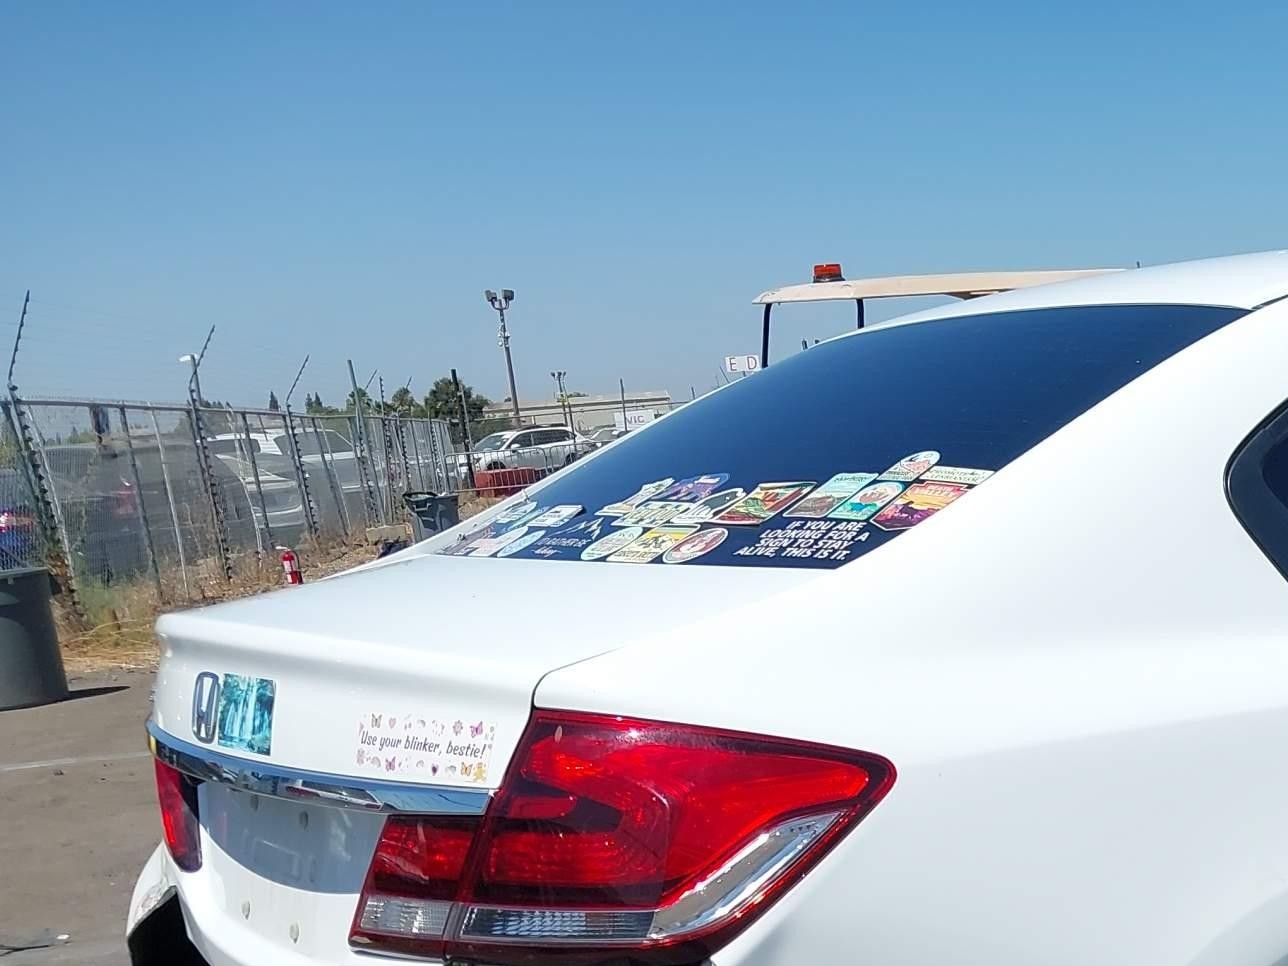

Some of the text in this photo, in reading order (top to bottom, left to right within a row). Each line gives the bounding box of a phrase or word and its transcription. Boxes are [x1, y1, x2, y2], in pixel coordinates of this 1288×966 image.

[785, 520, 867, 531] IF YOU ARE
[759, 529, 870, 541] LOOKING FOR A
[755, 538, 854, 550] SIGN TO STAY
[732, 546, 851, 560] ALIVE, THIS IS IT.
[360, 730, 487, 759] Use your blinker, bestie!
